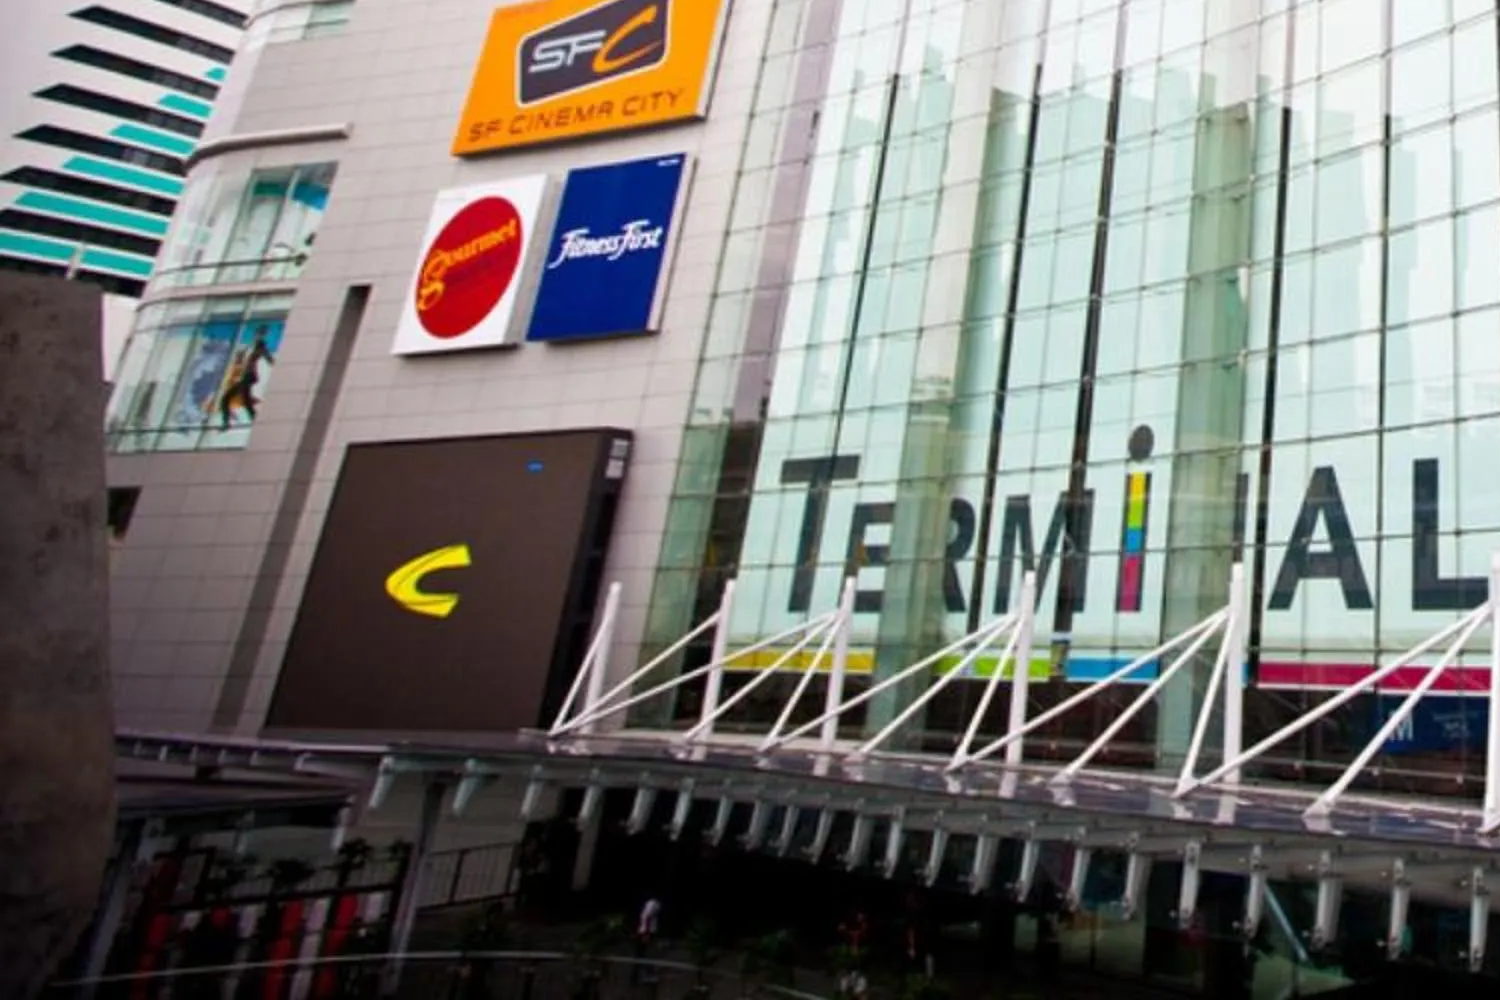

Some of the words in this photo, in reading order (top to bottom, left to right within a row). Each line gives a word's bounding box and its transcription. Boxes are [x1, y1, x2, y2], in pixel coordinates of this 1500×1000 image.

[528, 4, 662, 74] SFC
[468, 119, 504, 143] SF
[508, 100, 613, 136] CINEMA
[621, 88, 684, 116] CITY
[548, 226, 618, 269] Fitness
[606, 219, 663, 260] First
